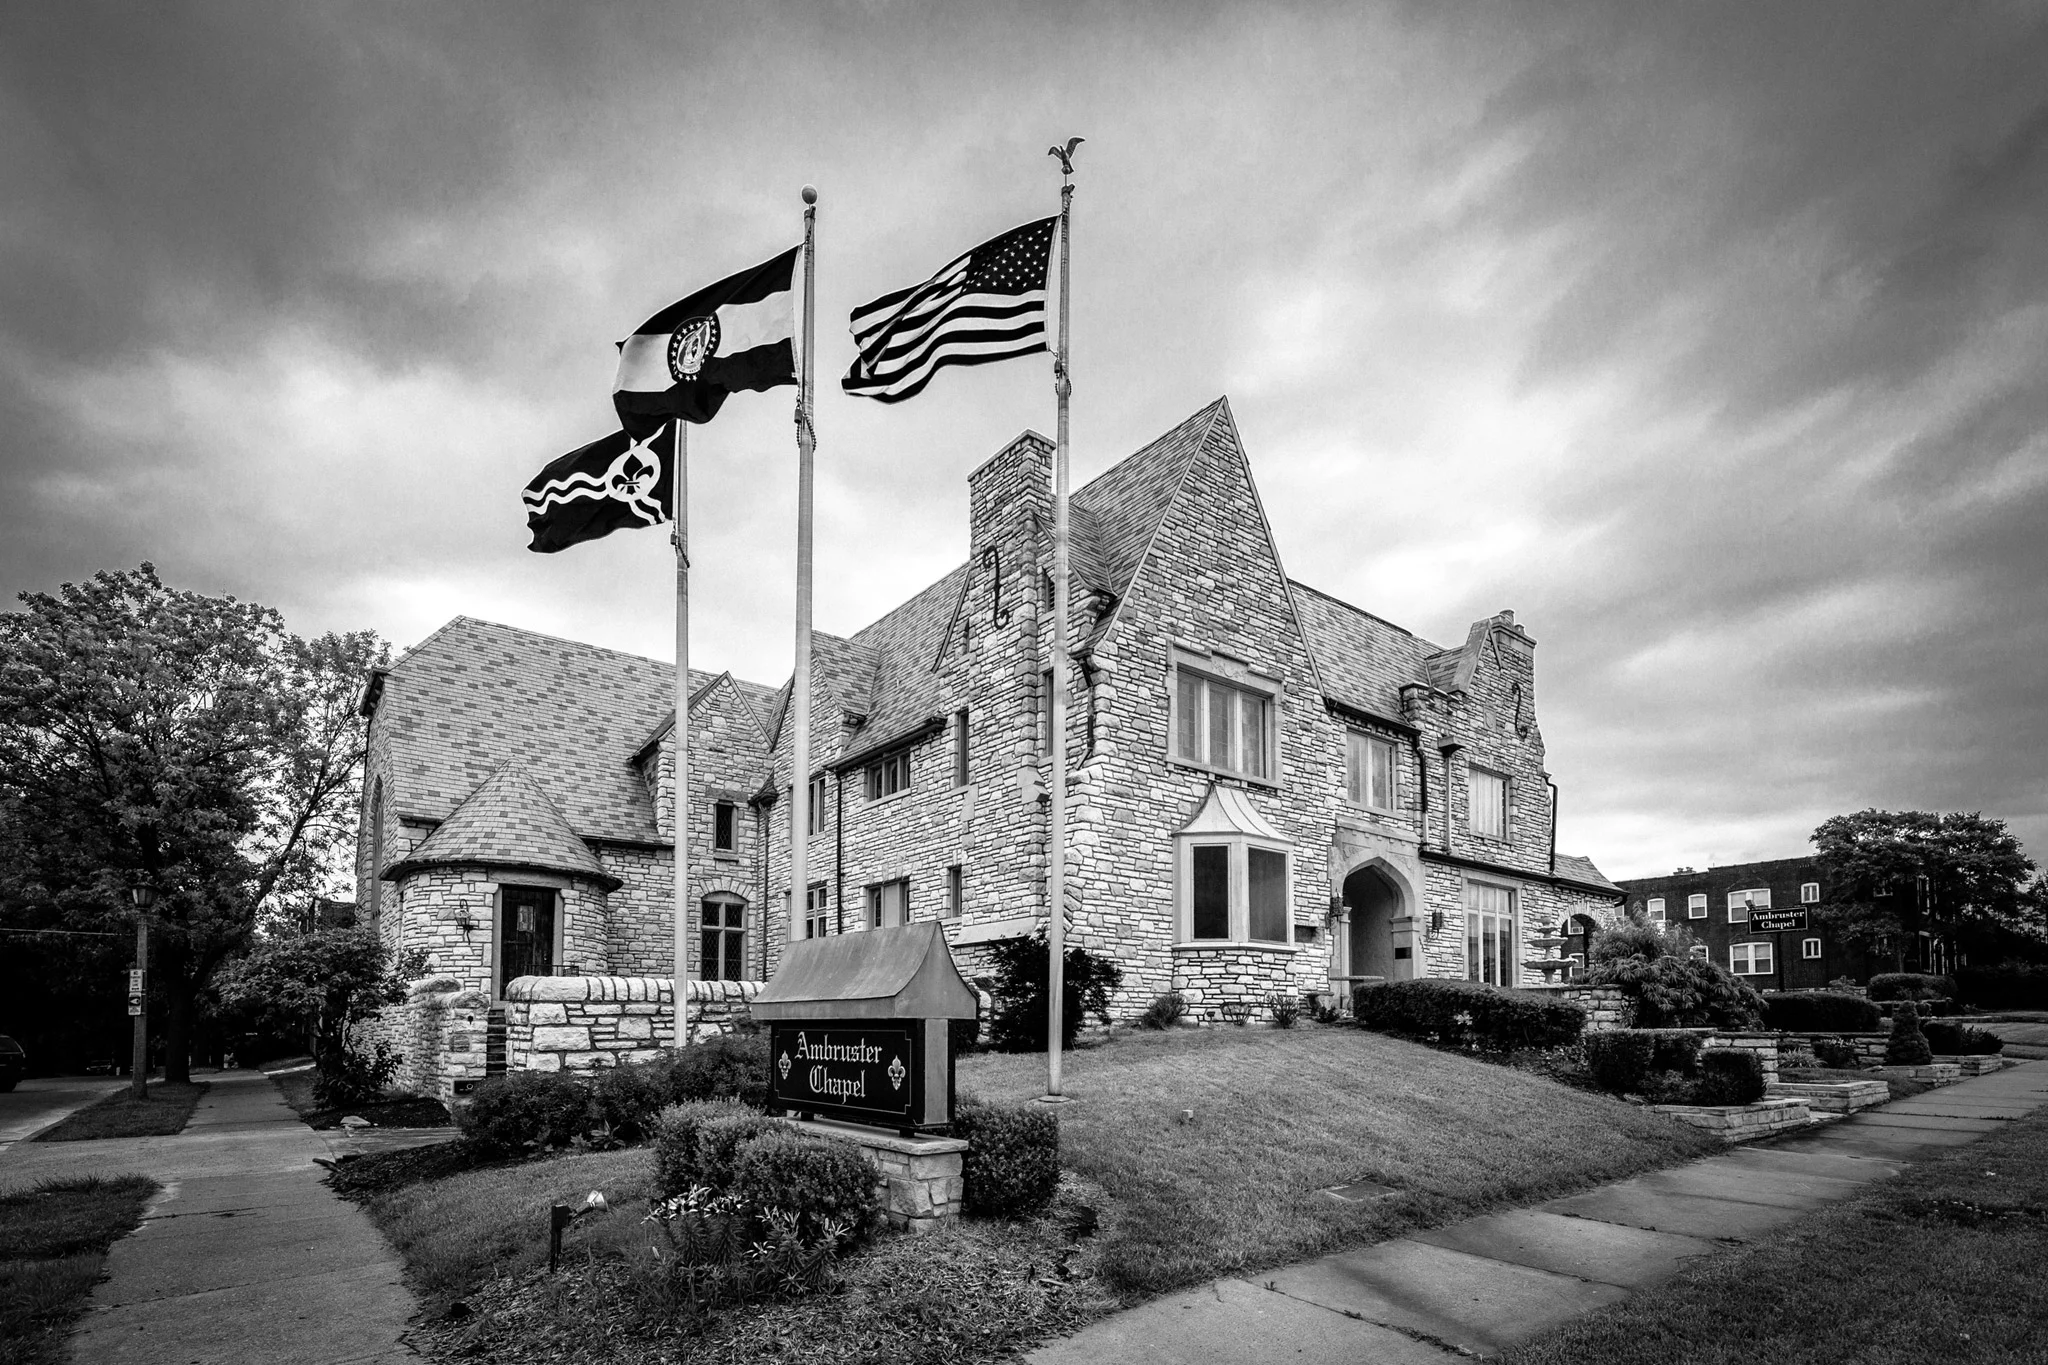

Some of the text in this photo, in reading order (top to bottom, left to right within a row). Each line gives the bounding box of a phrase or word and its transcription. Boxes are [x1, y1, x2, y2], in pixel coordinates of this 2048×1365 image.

[1752, 911, 1804, 920] Ambruster
[1761, 919, 1795, 929] Chapel
[794, 1031, 883, 1064] Ambruster
[809, 1064, 866, 1105] Chapel
